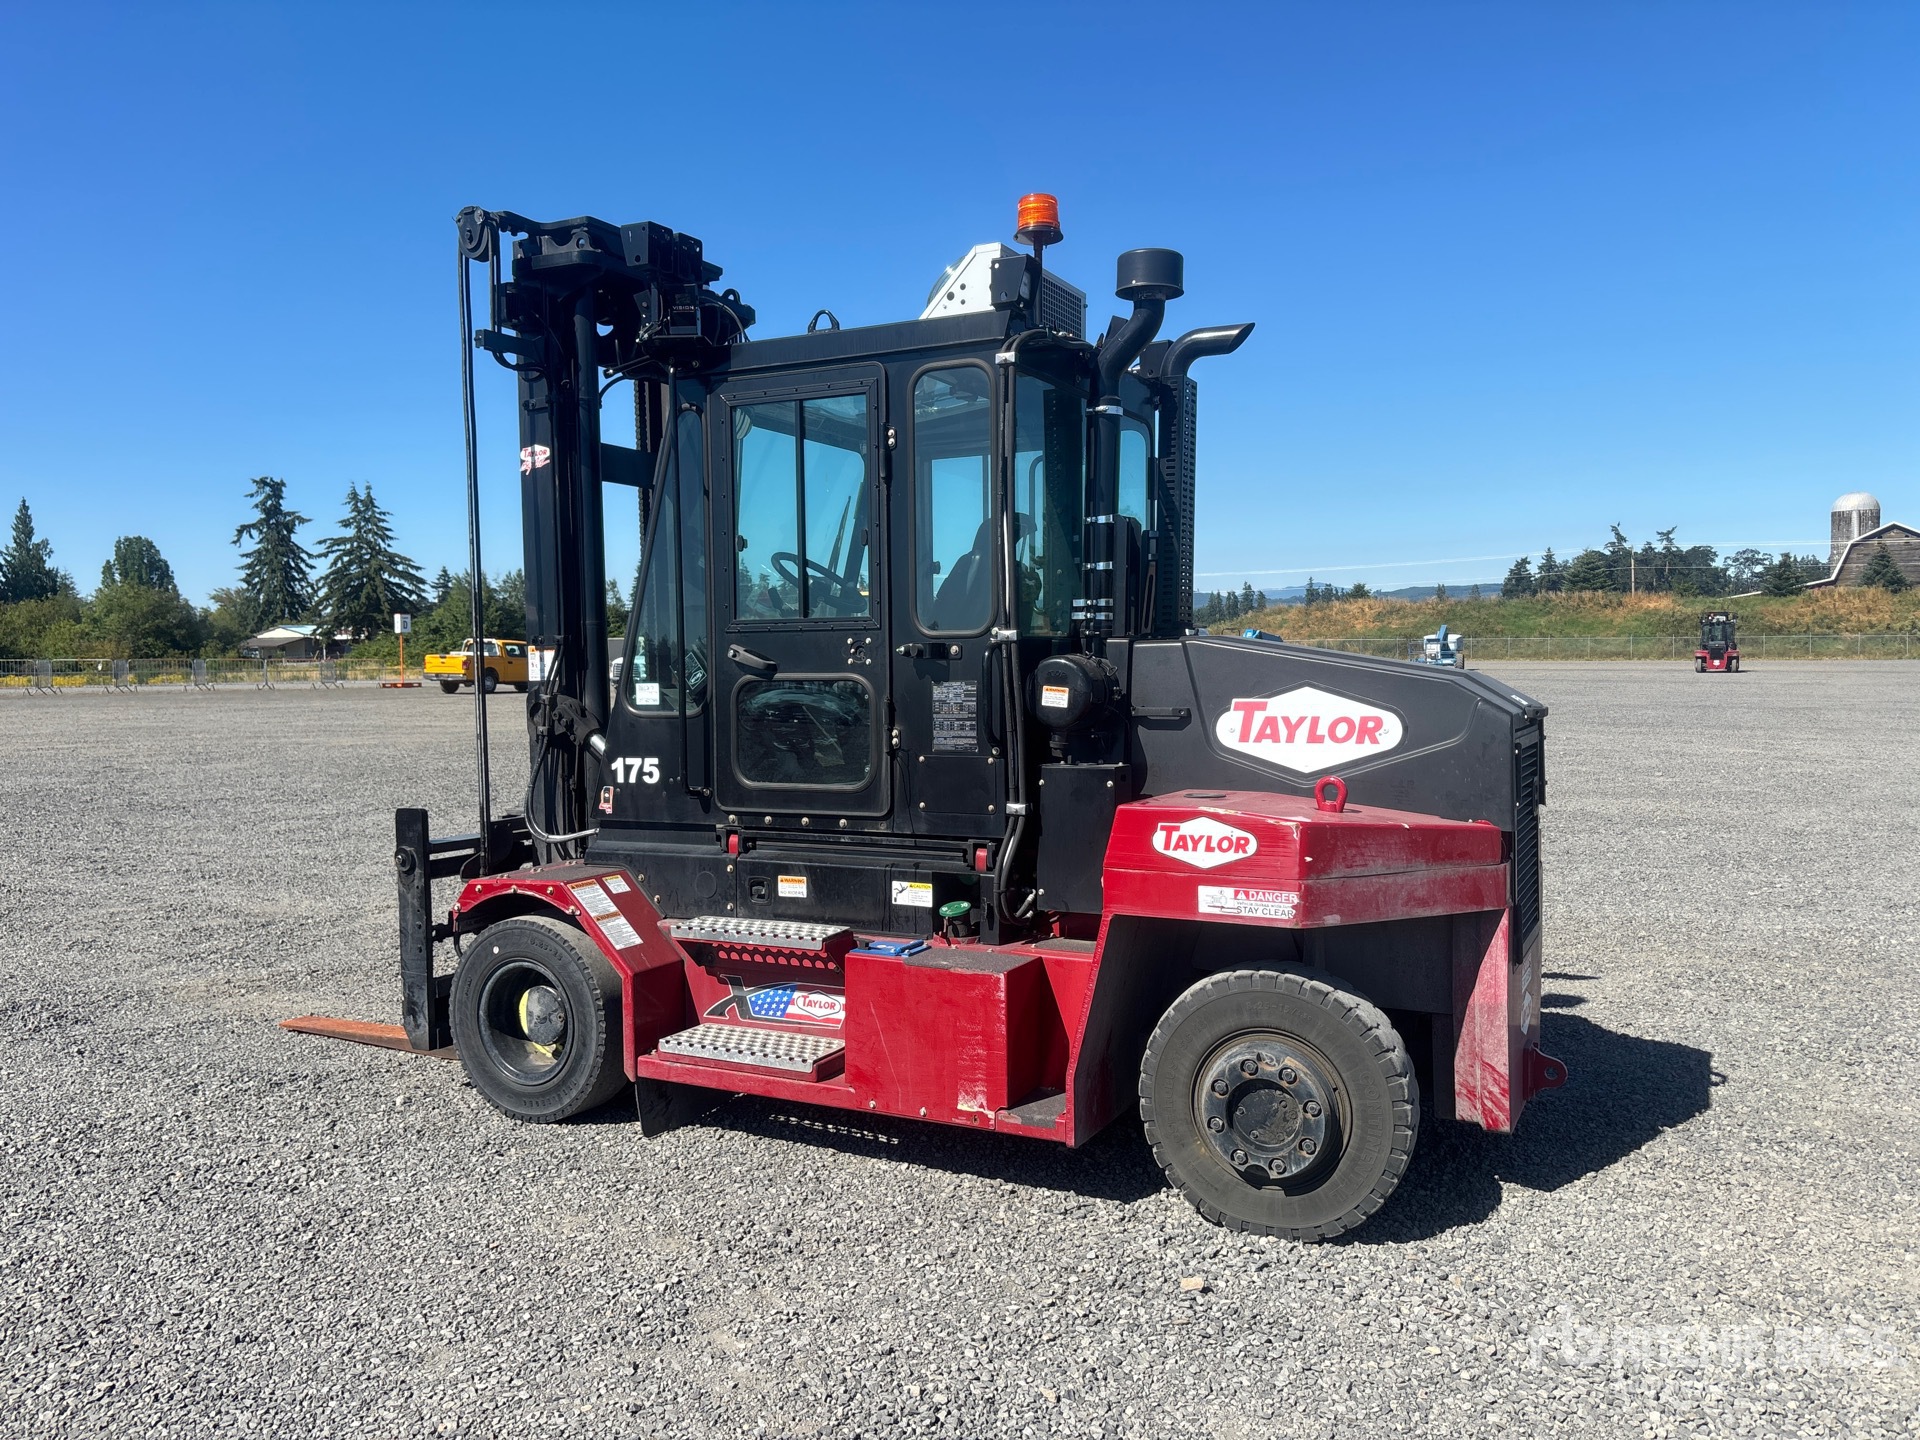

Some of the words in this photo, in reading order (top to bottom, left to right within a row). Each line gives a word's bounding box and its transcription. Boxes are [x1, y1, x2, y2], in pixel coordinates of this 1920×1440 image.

[1233, 701, 1384, 745] TAYLOR
[611, 757, 660, 784] 175
[1160, 825, 1250, 854] TAYLOR
[1250, 891, 1298, 903] DANGER
[1237, 906, 1259, 915] STAY
[1262, 908, 1294, 917] CLEAR
[801, 995, 836, 1010] TAYLOR
